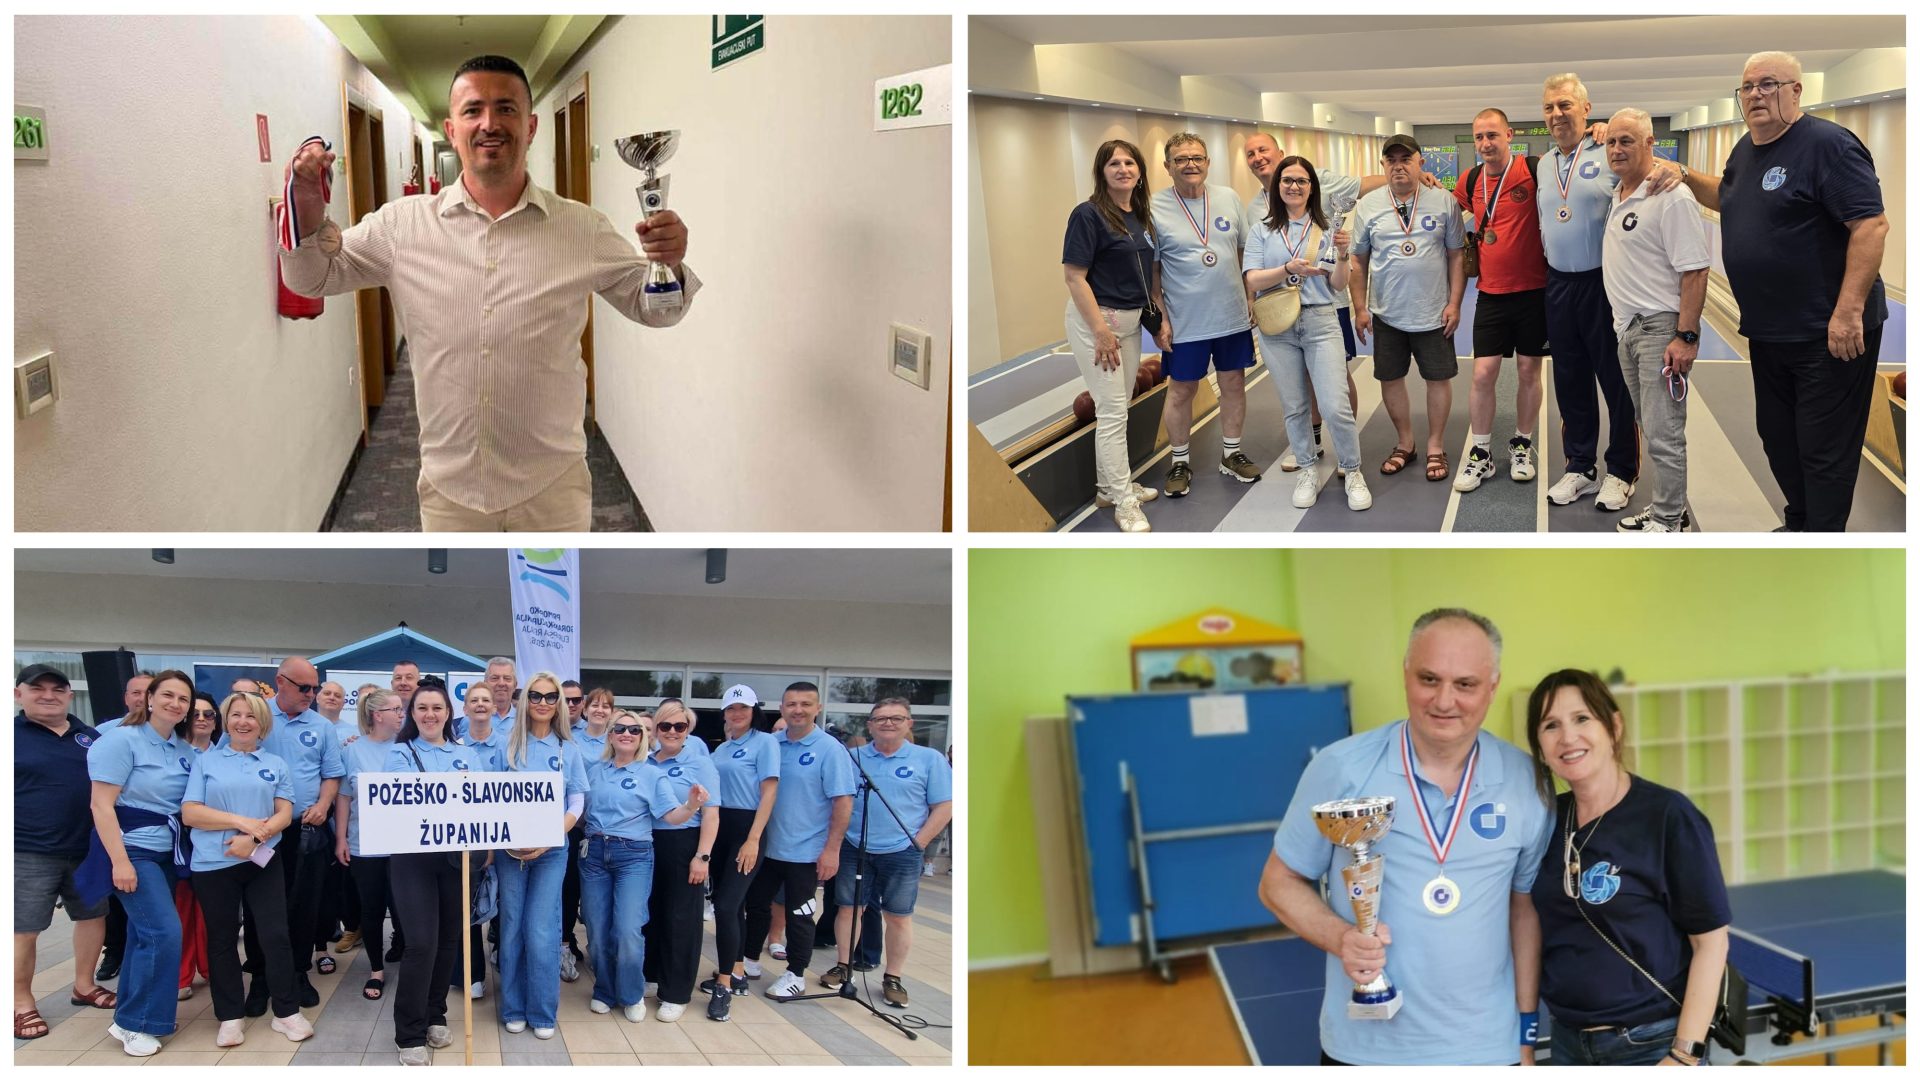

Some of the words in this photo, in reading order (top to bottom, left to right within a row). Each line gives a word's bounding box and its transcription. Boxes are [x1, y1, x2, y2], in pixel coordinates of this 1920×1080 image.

[880, 84, 923, 119] 1262
[368, 778, 448, 805] POŽEŠKO
[462, 781, 555, 804] SLAVONSKA
[420, 819, 511, 846] ŽUPANIJA
